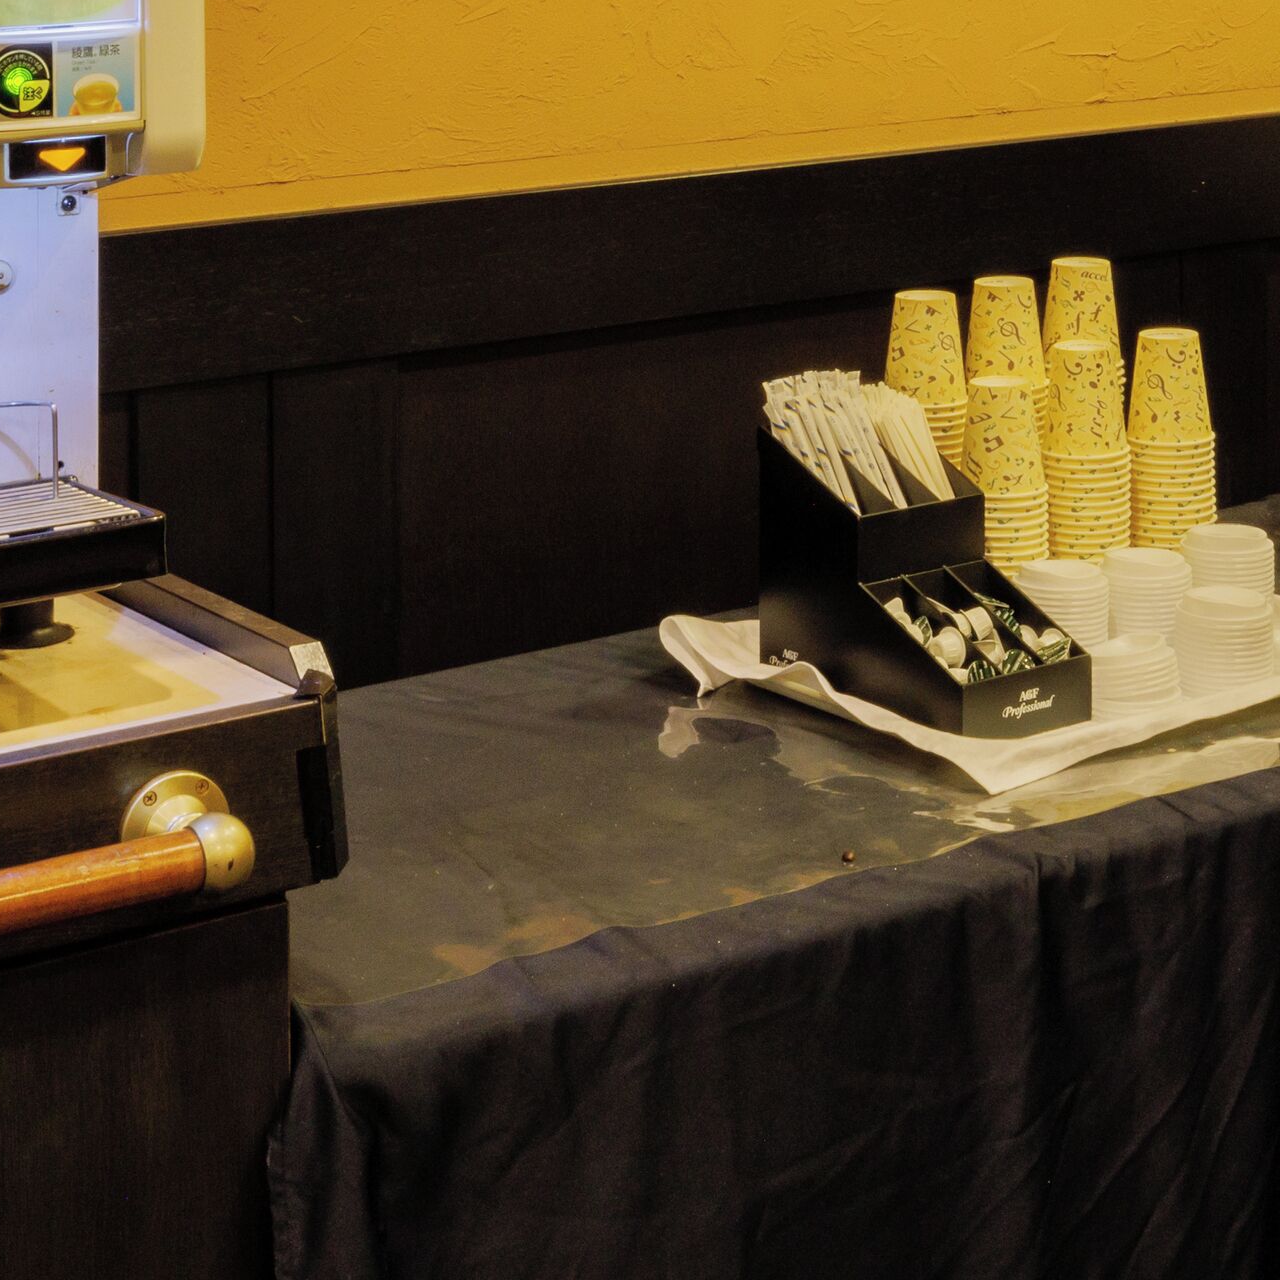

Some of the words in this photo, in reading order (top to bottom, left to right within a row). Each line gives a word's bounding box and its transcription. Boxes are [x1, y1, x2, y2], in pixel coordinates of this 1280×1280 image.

[23, 87, 43, 100] 注ぐ
[782, 648, 799, 662] AGF
[1019, 687, 1039, 702] AGF
[1002, 694, 1055, 719] Professional
